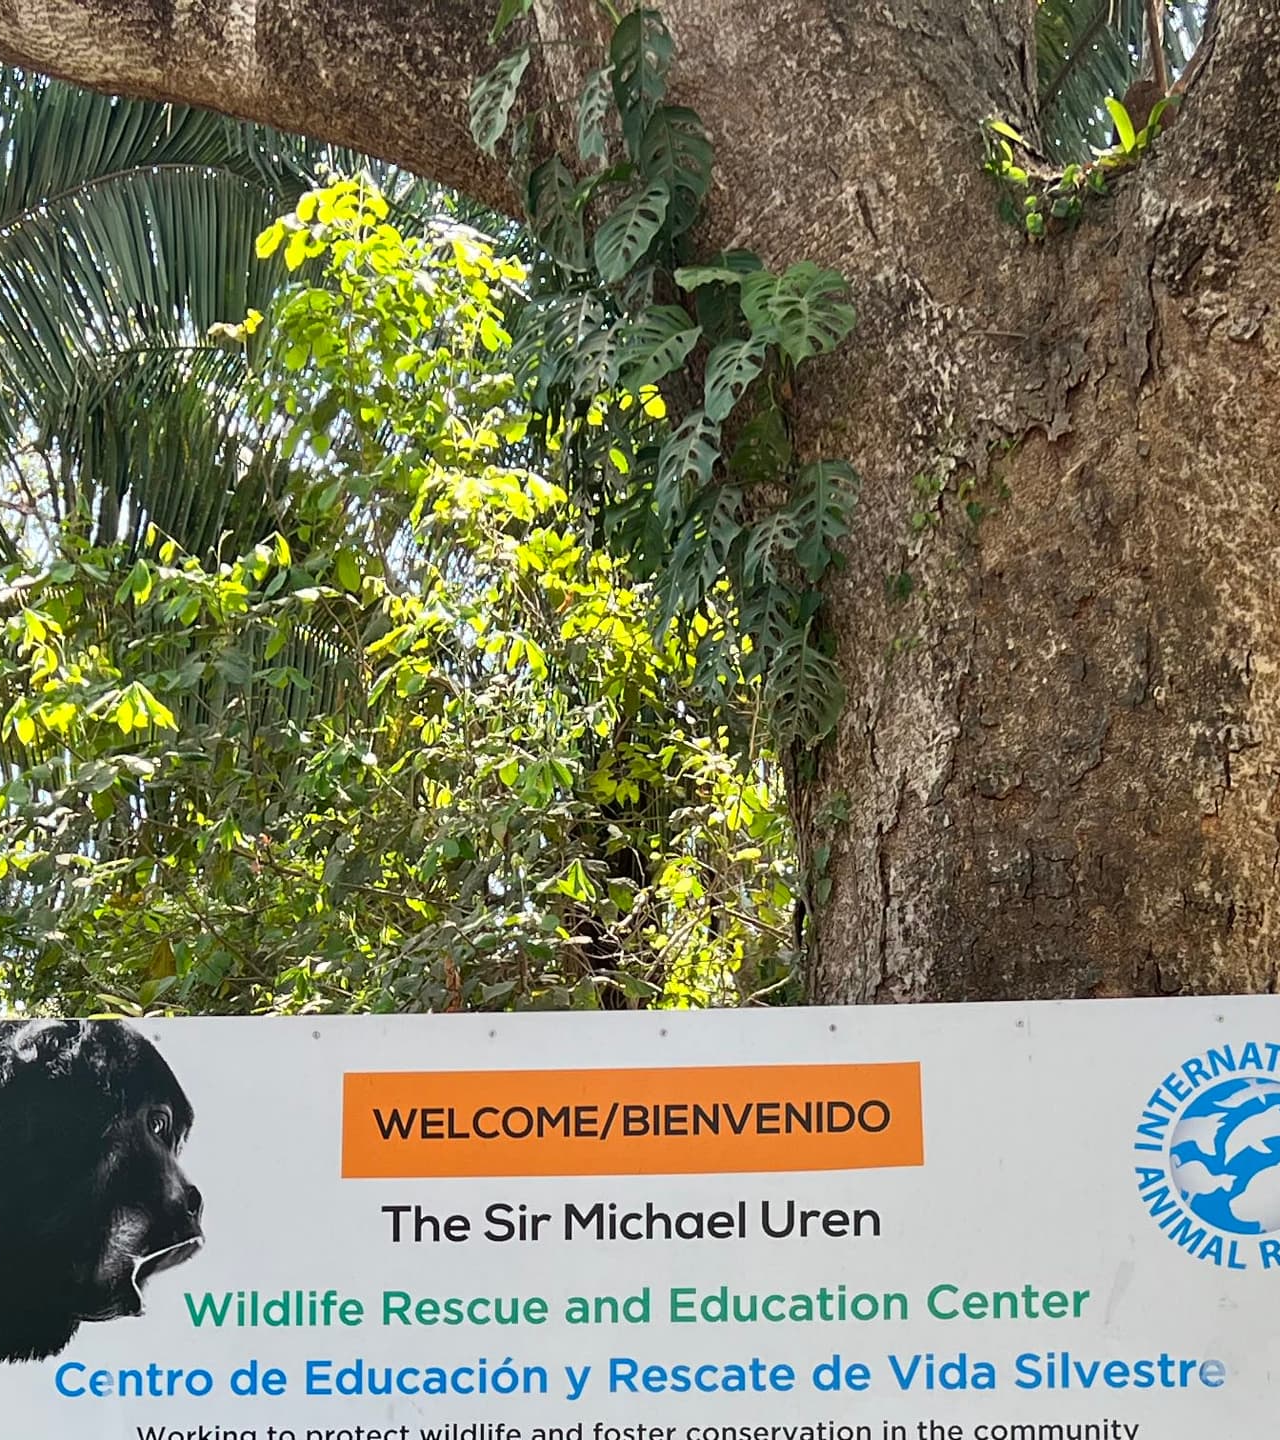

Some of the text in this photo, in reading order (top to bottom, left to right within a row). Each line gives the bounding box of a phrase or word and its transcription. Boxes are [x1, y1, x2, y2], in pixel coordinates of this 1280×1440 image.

[373, 1100, 890, 1141] WELCOME/BIENVENIDO
[380, 1199, 881, 1243] The Sir Michael Uren
[1134, 1166, 1248, 1270] ANIMAL
[183, 1283, 1091, 1328] Wildlife Rescue and Education Center
[54, 1351, 1225, 1401] Centro de Educación y Rescate de Vida Silvestre
